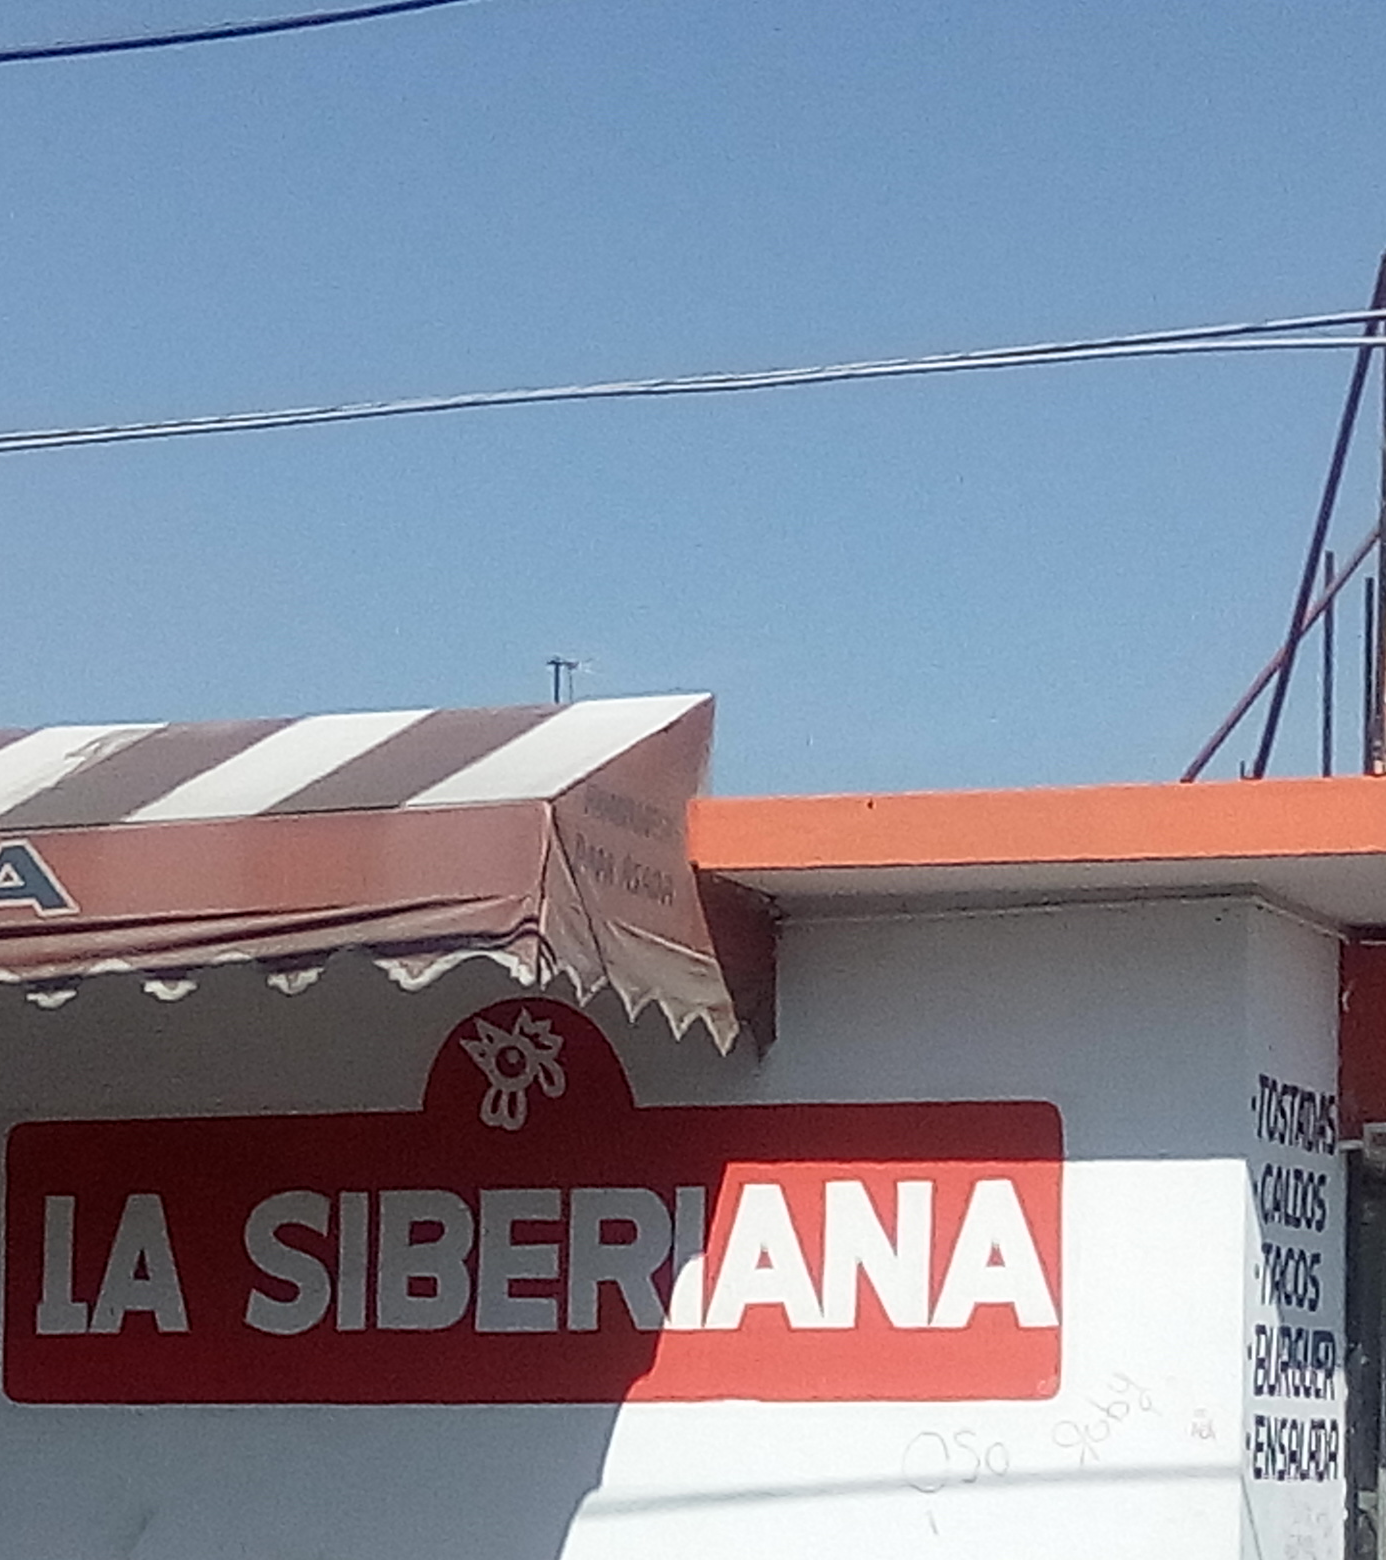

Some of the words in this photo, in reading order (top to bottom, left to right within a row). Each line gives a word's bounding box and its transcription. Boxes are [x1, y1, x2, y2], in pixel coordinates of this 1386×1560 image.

[1261, 1162, 1327, 1233] CALDOS
[36, 1193, 191, 1335] LA
[244, 1179, 1060, 1335] SIBERIANA
[1261, 1242, 1322, 1312] TACOS
[1253, 1414, 1339, 1481] ENSALADA
